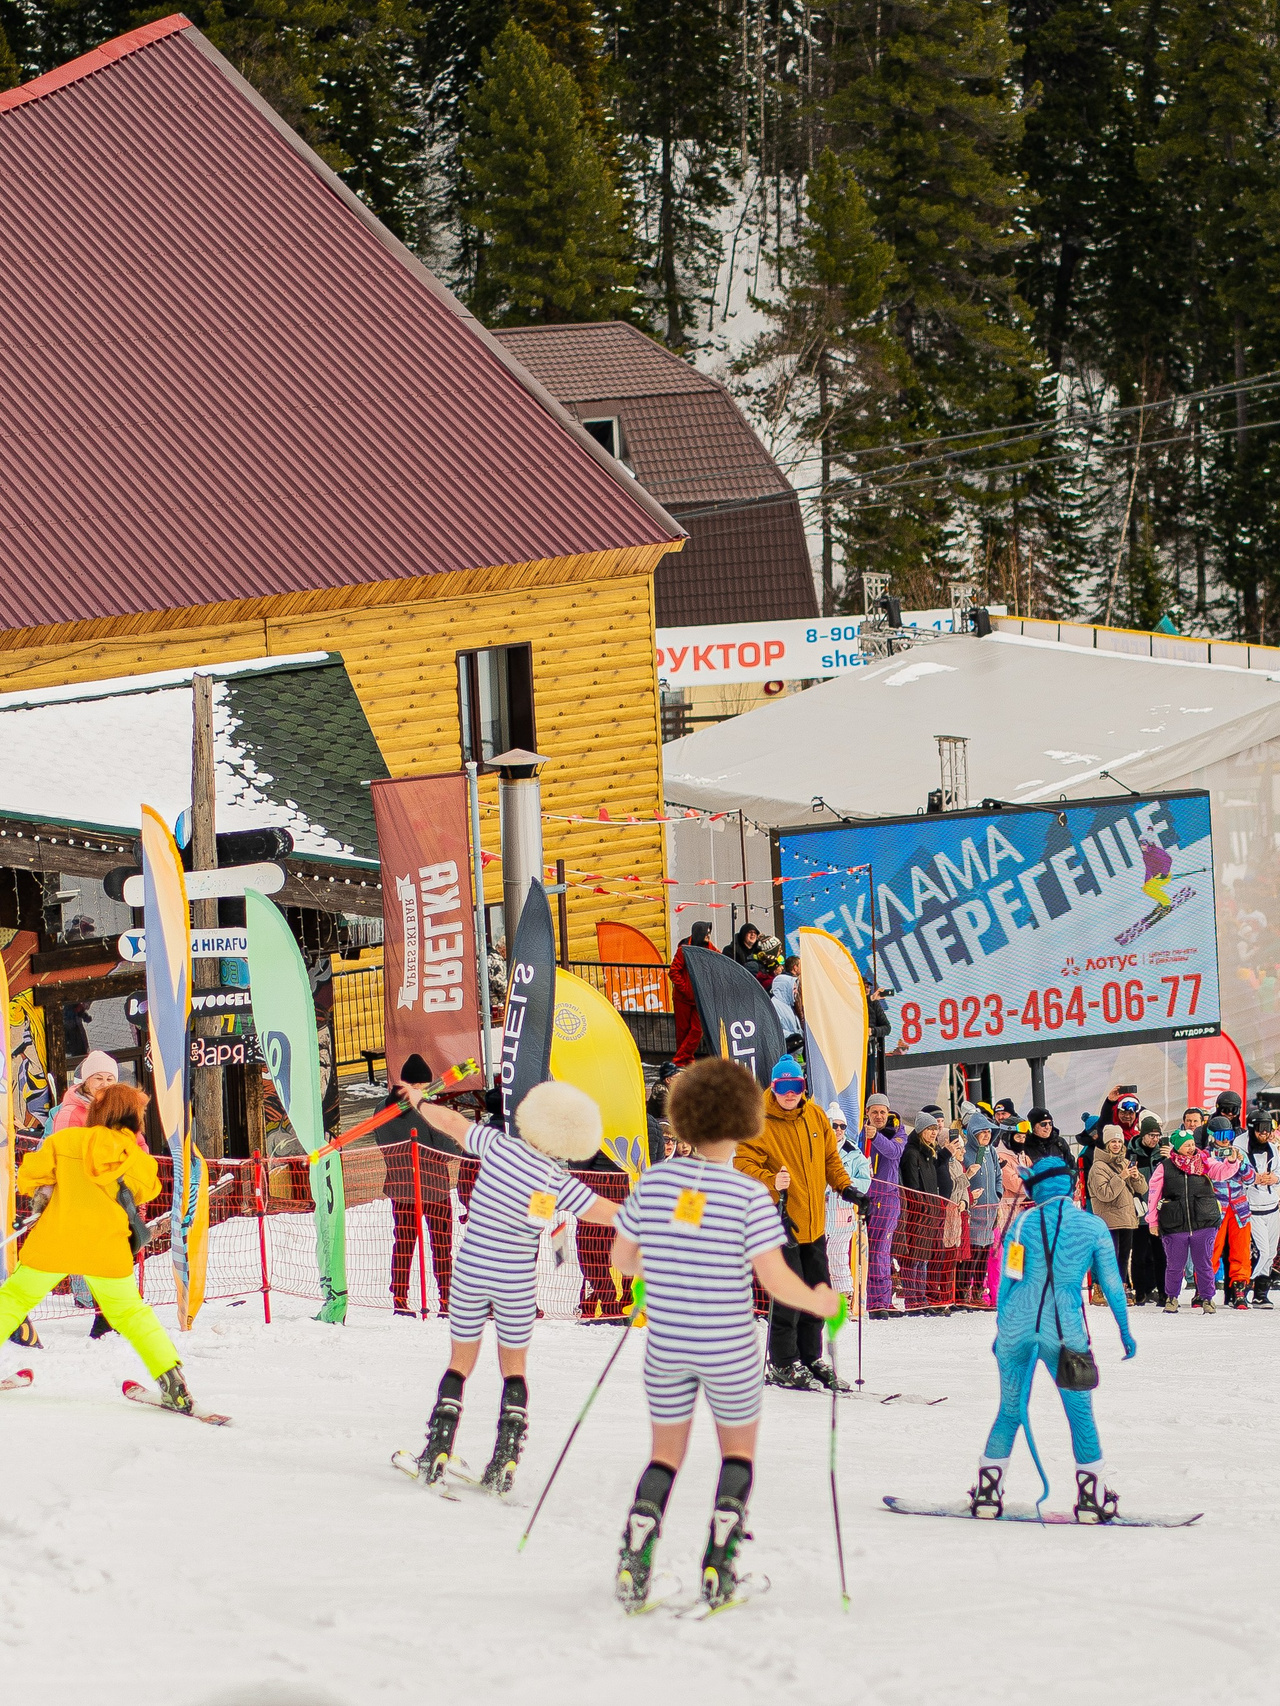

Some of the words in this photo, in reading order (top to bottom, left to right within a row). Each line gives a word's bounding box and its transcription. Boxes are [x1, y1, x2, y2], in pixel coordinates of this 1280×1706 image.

[202, 937, 247, 951] HIRAFU
[901, 973, 1202, 1045] 8-923-464-06-77
[1174, 1026, 1215, 1038] АУТДОР.РФ
[197, 1037, 245, 1067] Заря
